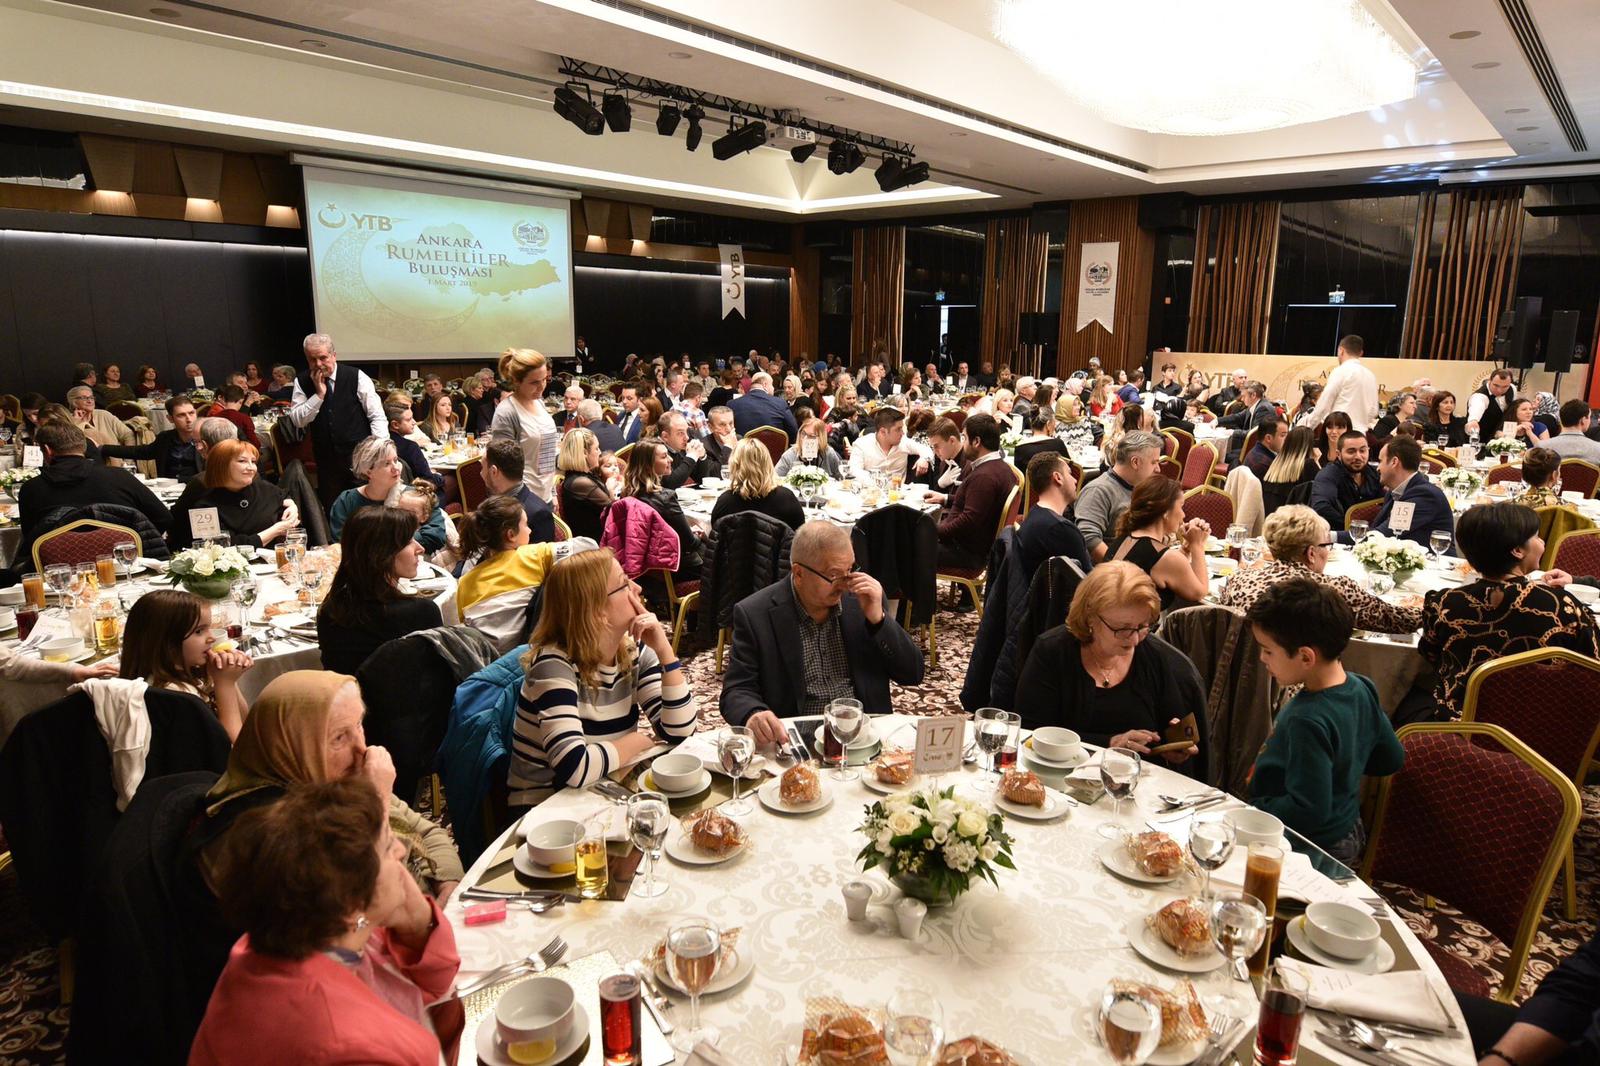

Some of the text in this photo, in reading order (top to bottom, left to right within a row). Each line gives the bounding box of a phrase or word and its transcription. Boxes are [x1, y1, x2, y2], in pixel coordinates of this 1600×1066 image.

[351, 213, 392, 231] YTB
[416, 233, 483, 249] ANKARA
[386, 244, 510, 267] RUMELİLİLER
[409, 261, 494, 278] BULUŞMASI
[730, 253, 740, 279] YTB
[195, 513, 213, 524] 29
[1396, 507, 1409, 516] 15
[927, 726, 955, 747] 17
